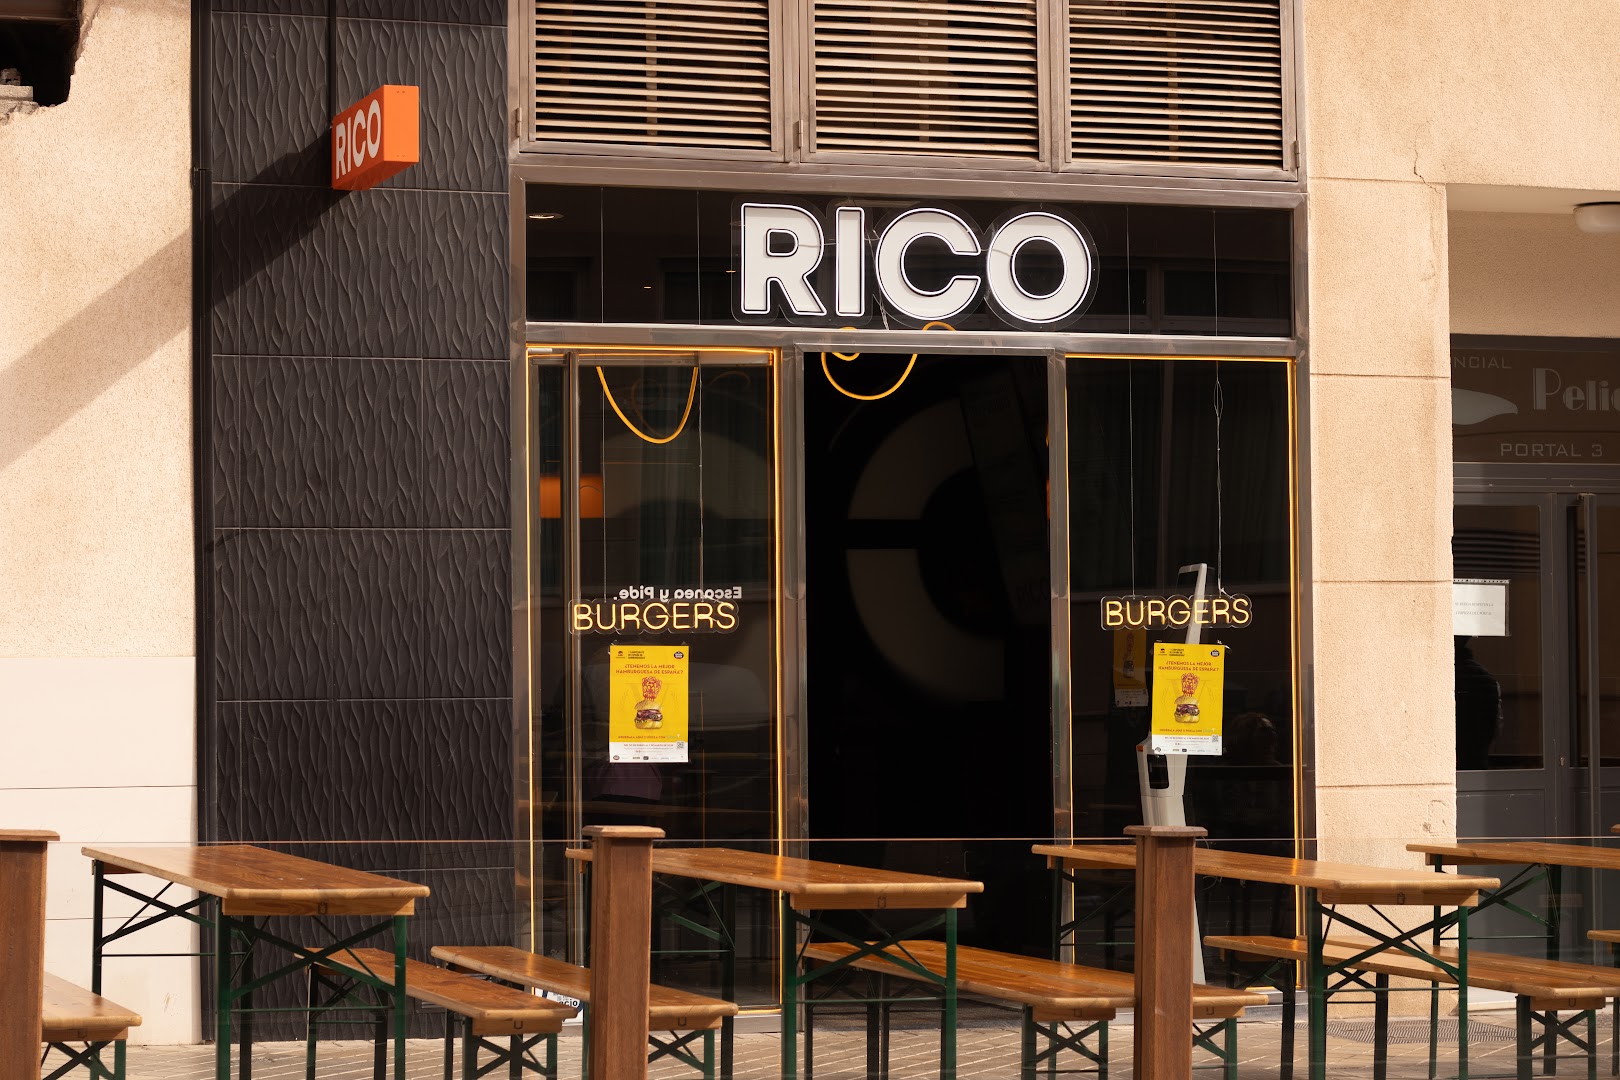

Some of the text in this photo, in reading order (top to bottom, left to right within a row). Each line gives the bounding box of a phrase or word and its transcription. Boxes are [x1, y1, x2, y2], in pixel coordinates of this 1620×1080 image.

[336, 99, 382, 180] RICO
[740, 202, 1092, 324] RICO
[1453, 355, 1512, 369] NCIAL
[1500, 443, 1603, 457] PORTAL 3
[573, 602, 736, 630] BURGERS
[1105, 598, 1250, 626] BURGERS
